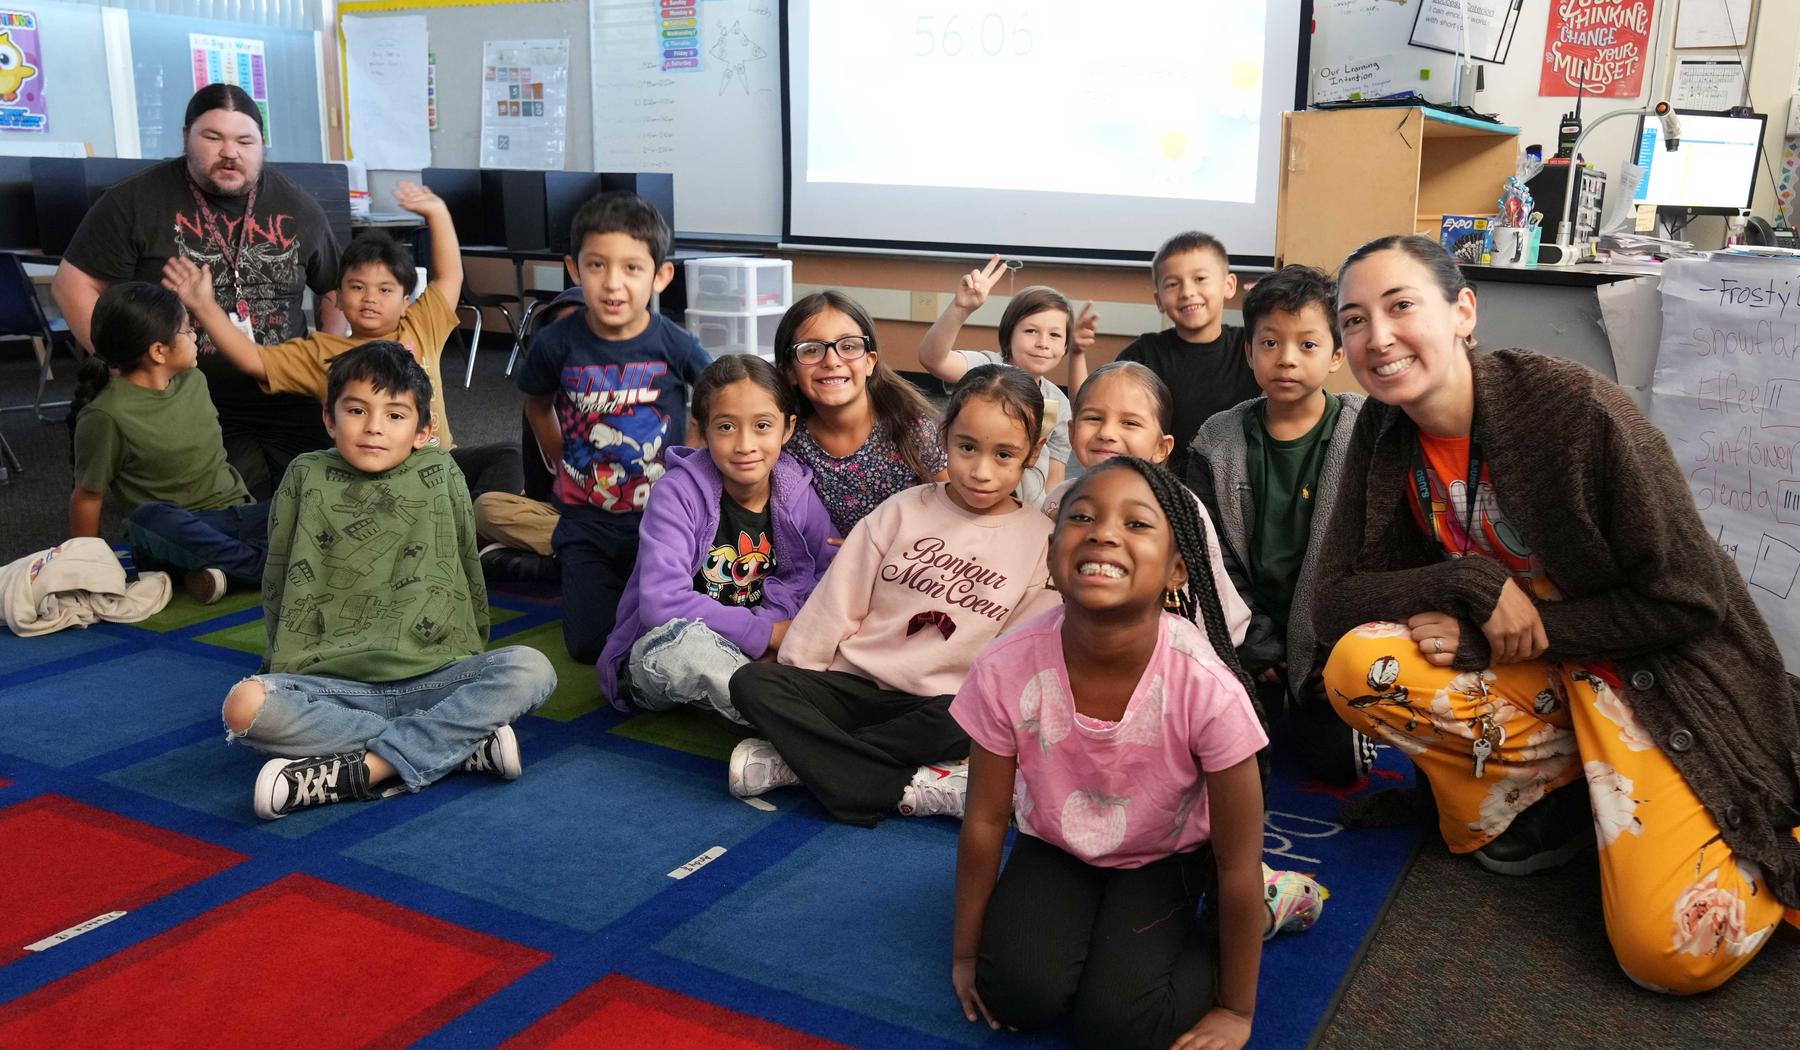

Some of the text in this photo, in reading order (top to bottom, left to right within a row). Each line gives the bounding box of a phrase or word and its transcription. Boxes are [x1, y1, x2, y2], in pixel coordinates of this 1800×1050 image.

[1560, 25, 1618, 48] CHANGE
[673, 49, 689, 58] Friday
[1594, 41, 1639, 63] YOUR
[1320, 61, 1380, 78] Our Learning
[1442, 218, 1474, 231] EXPO
[560, 361, 669, 407] SONIC
[902, 537, 1007, 590] Bonjour
[881, 562, 1010, 622] Mon Coeur
